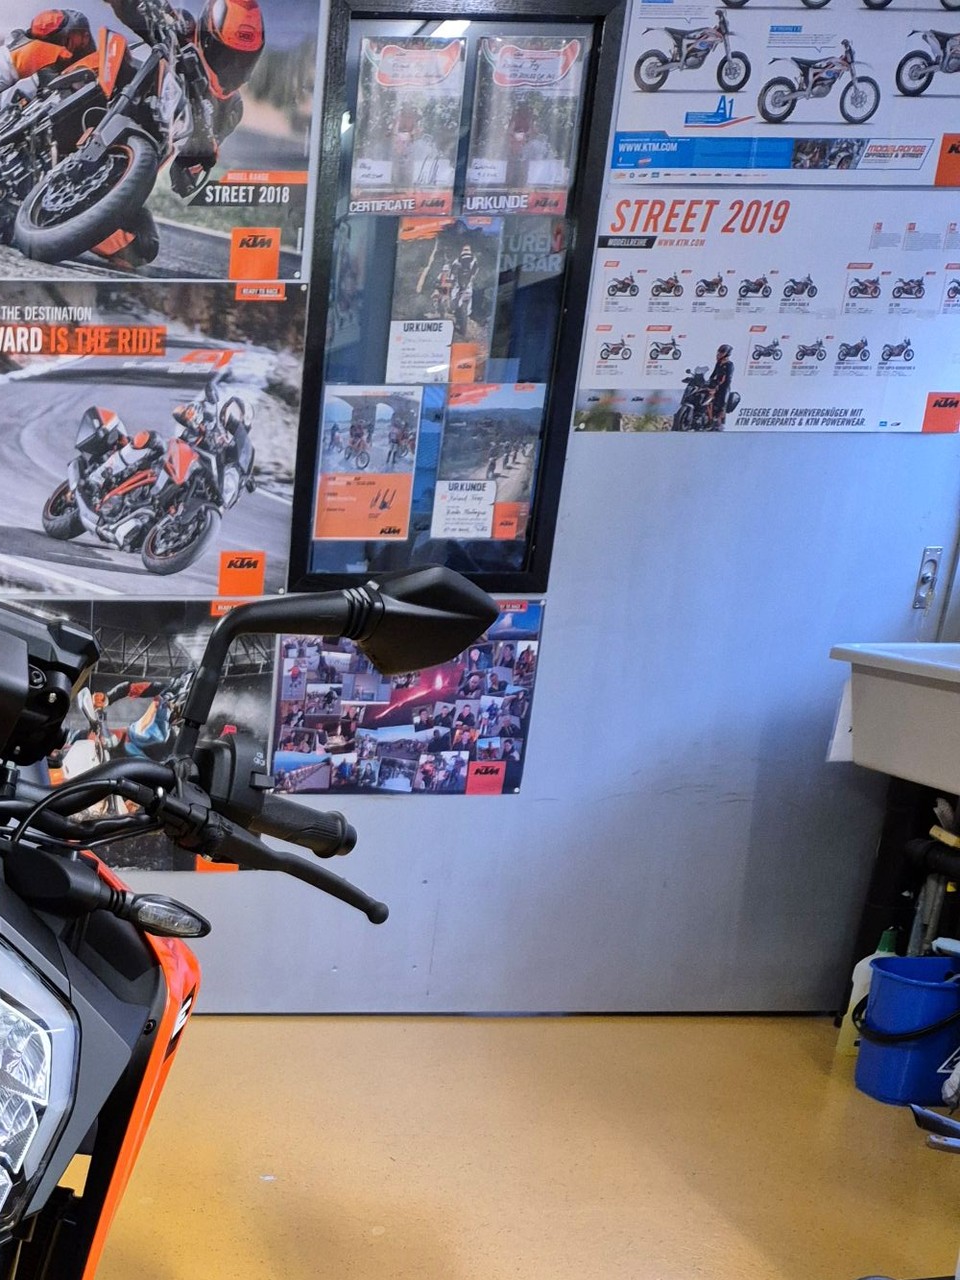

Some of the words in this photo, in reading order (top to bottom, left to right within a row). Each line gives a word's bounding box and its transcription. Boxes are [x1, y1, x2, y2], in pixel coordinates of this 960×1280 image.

[618, 142, 678, 152] WWW.KTM.COM
[205, 185, 255, 203] STREET
[258, 186, 290, 203] 2018
[349, 198, 416, 213] CERTIFICATE
[466, 194, 529, 211] URKUNDE
[610, 199, 721, 234] STREET
[720, 199, 791, 234] 2019
[238, 234, 272, 249] KTM
[0, 306, 21, 321] THE
[24, 306, 92, 321] DESTINATION
[403, 322, 443, 333] URKUNDE
[50, 327, 69, 353] IS
[76, 328, 111, 354] THE
[117, 328, 163, 354] RIDE
[933, 397, 960, 408] KTM
[738, 408, 772, 417] STEIGERE
[772, 408, 790, 416] DEIN
[790, 406, 850, 417] FAHRVERGNÜGEN
[850, 408, 863, 417] MIT
[735, 417, 750, 426] KTM
[750, 417, 797, 426] POWERPARTS
[797, 418, 803, 426] &
[805, 418, 821, 426] KTM
[448, 482, 487, 492] URKUNDE
[380, 526, 401, 535] KTM
[227, 556, 260, 569] KTM
[474, 766, 499, 775] KTM
